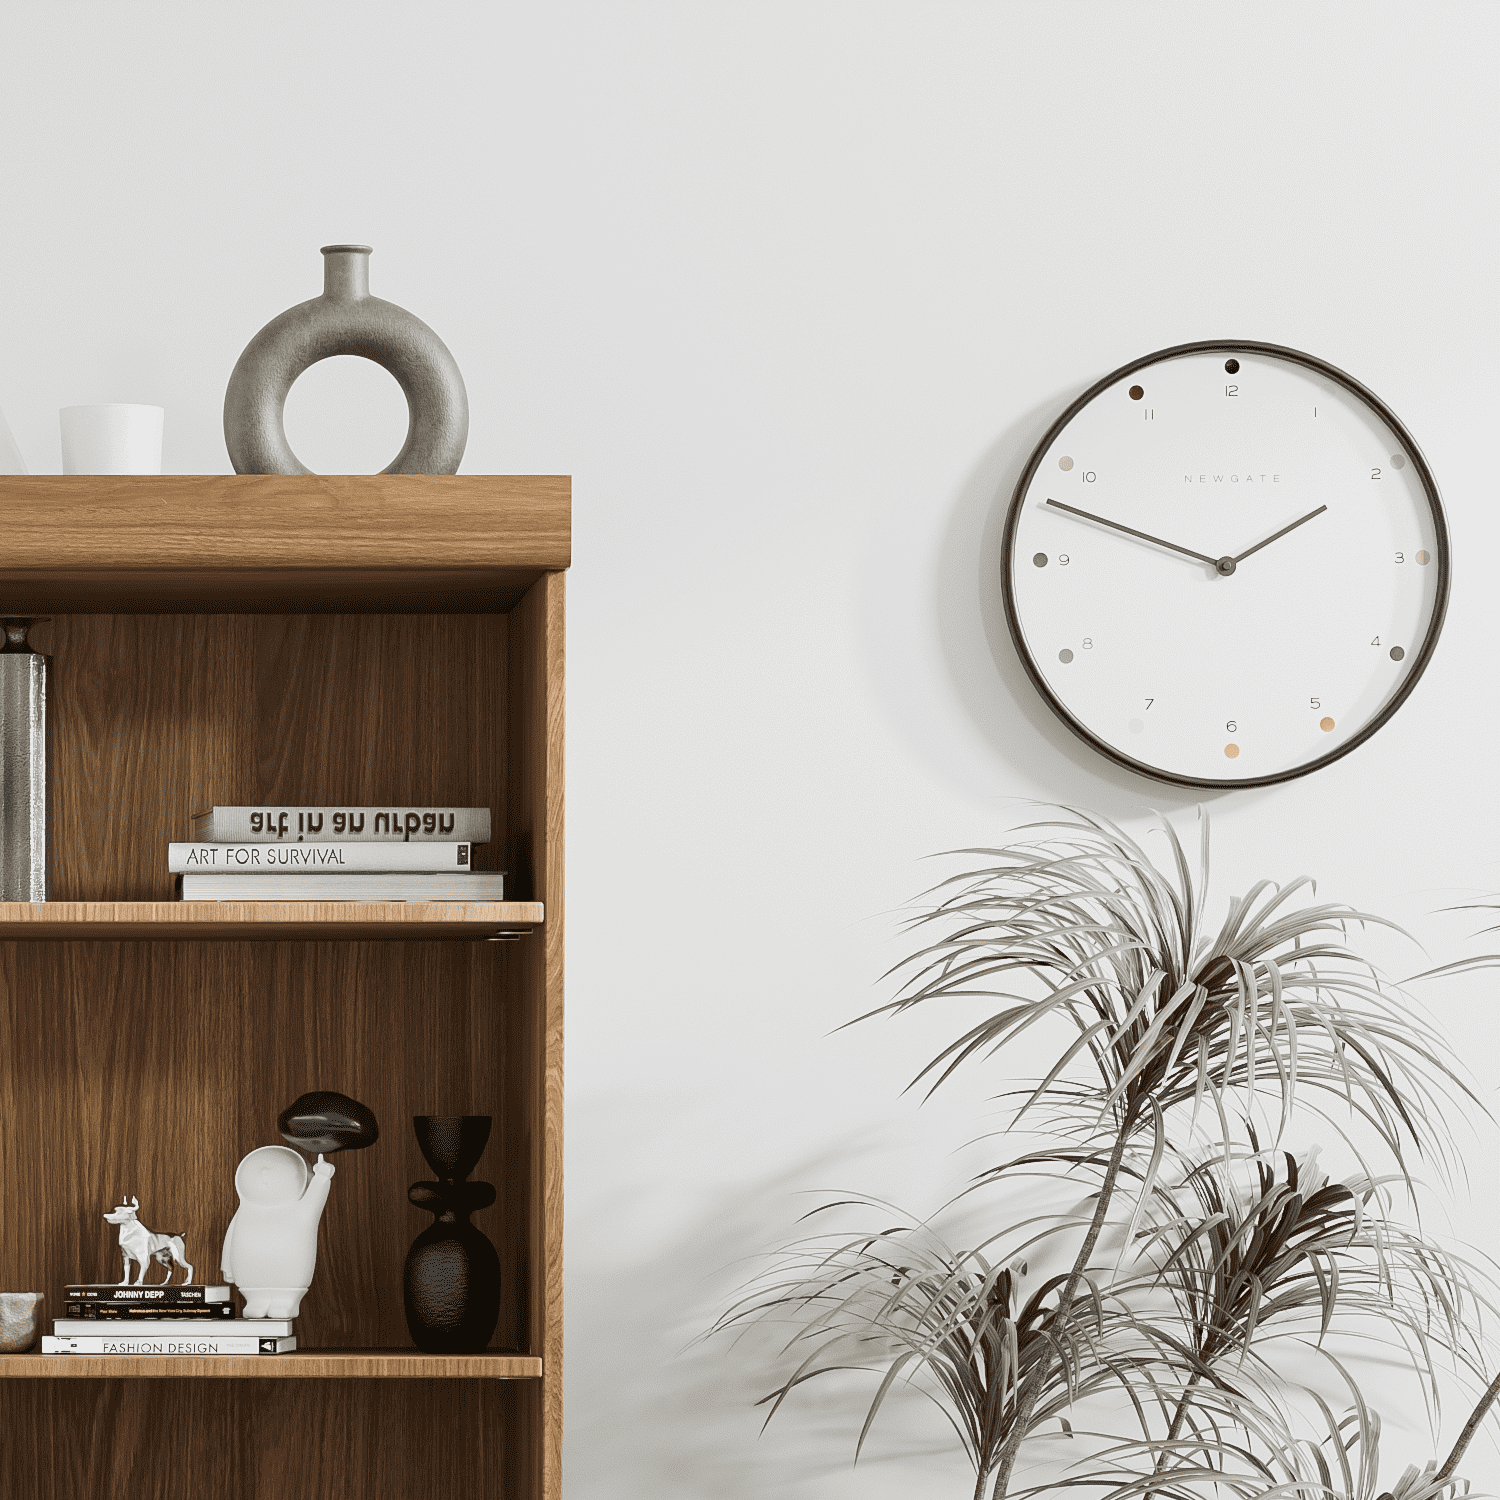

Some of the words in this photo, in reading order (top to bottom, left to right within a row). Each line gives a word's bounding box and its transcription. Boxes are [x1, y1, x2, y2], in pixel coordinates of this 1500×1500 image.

[1224, 384, 1239, 397] 12
[1144, 408, 1154, 421] 11
[1082, 471, 1097, 484] 10
[1184, 474, 1281, 484] NEWGATE
[1370, 467, 1382, 480] 2
[1058, 553, 1070, 567] 9
[1394, 551, 1405, 564] 3
[1081, 637, 1094, 650] 8
[1370, 635, 1382, 648] 4
[1144, 698, 1155, 711] 7
[1310, 697, 1321, 710] 5
[1225, 720, 1238, 733] 6
[186, 848, 219, 865] ART
[226, 848, 261, 865] FOR
[267, 848, 346, 865] SURVIVAL
[113, 1290, 144, 1299] JOHNNY
[144, 1290, 165, 1299] DEPP
[103, 1342, 163, 1353] FASHION
[168, 1342, 219, 1353] DESIGN
